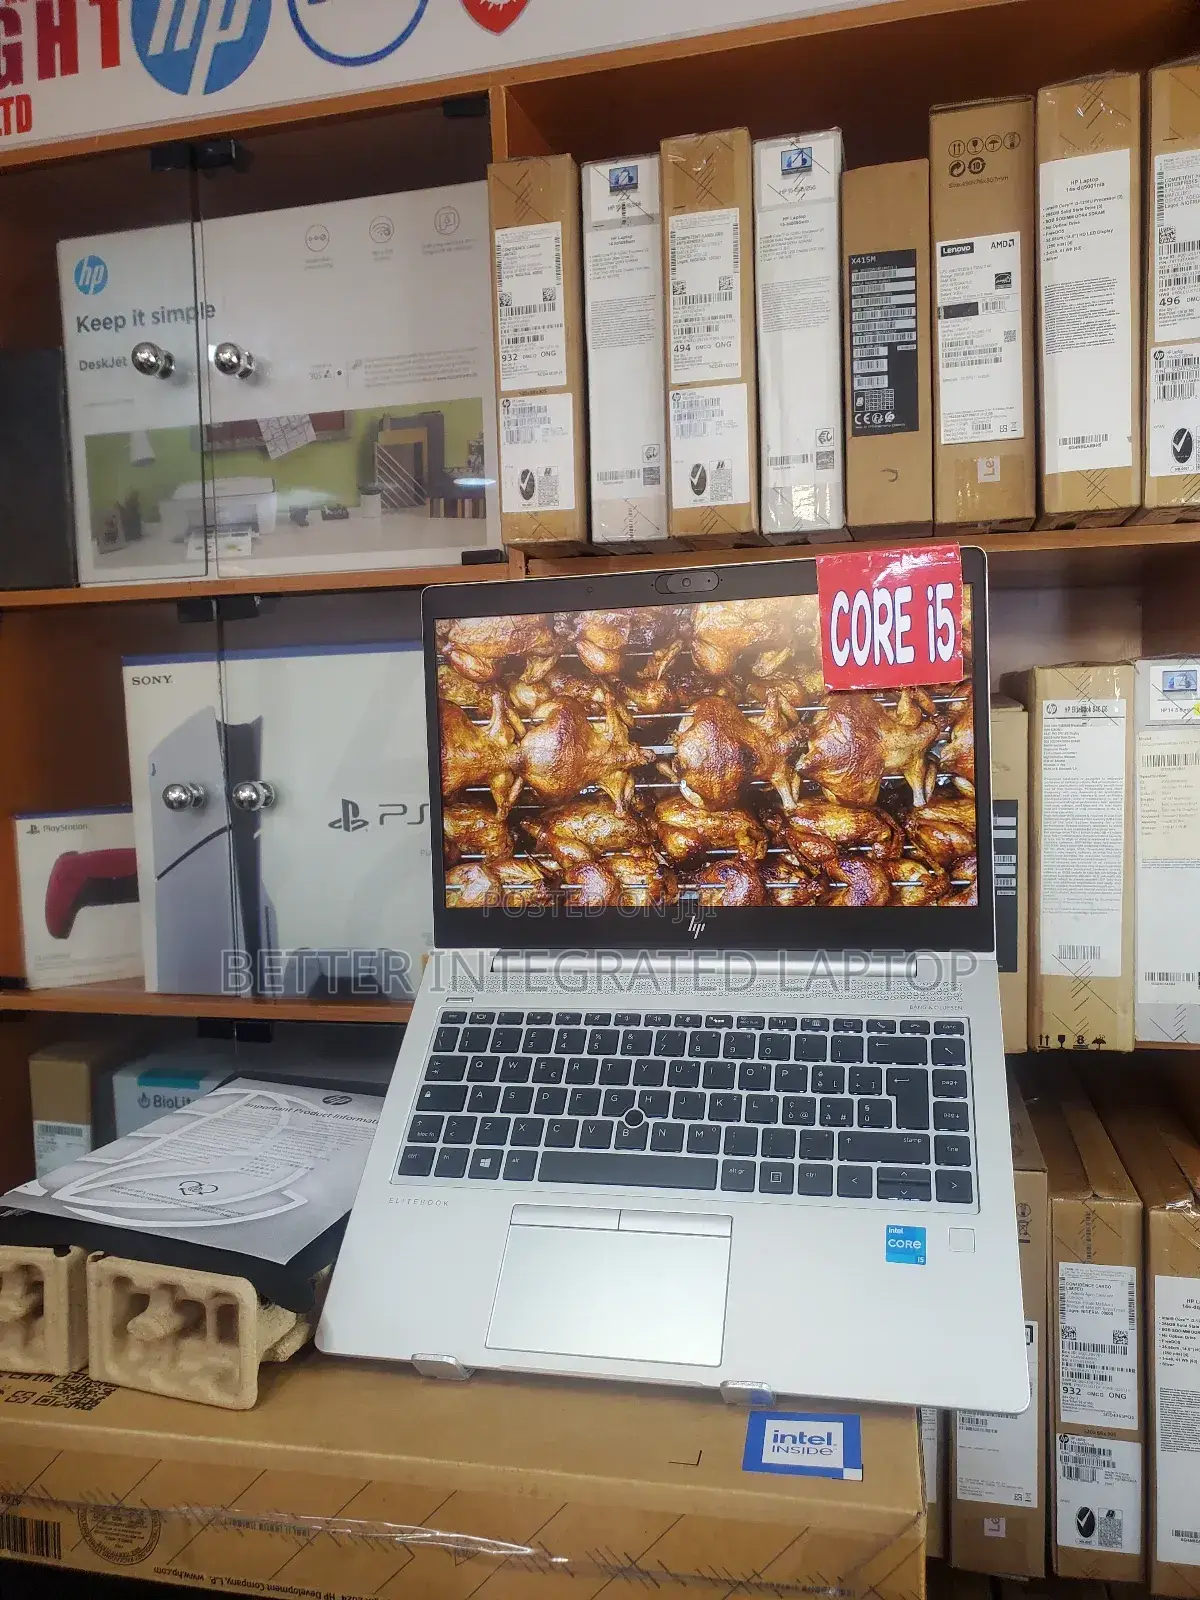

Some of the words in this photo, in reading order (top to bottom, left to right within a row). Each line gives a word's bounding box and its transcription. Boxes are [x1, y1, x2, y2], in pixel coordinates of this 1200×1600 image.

[0, 94, 33, 136] TD
[942, 244, 972, 255] Lenovo
[991, 240, 1008, 249] AMD
[851, 255, 877, 265] X415M
[79, 256, 104, 294] hp
[1159, 296, 1180, 306] 496
[76, 315, 127, 333] Keep
[132, 309, 145, 326] it
[151, 301, 216, 325] simple
[673, 344, 691, 353] 494
[501, 353, 518, 362] 932
[540, 350, 557, 358] ONG
[79, 356, 128, 371] DeskJet
[830, 585, 916, 667] CORE
[927, 582, 956, 665] i5
[131, 675, 172, 687] SONY
[43, 822, 88, 834] PlayStation
[688, 916, 706, 939] hp
[508, 1061, 518, 1069] W
[573, 1063, 580, 1071] R
[606, 1063, 613, 1071] T
[675, 1065, 683, 1073] U
[476, 1091, 484, 1099] A
[542, 1092, 549, 1100] D
[611, 1094, 618, 1102] G
[645, 1095, 652, 1103] H
[153, 1094, 191, 1109] BioLit
[244, 1102, 292, 1113] Important
[293, 1108, 332, 1119] Product
[588, 1126, 595, 1134] V
[659, 1129, 666, 1137] N
[695, 1130, 704, 1138] M
[389, 1198, 449, 1206] ELITEBOOK
[888, 1226, 904, 1235] intel
[1062, 1386, 1082, 1396] 932
[1108, 1392, 1127, 1400] ONG
[772, 1430, 832, 1446] intel
[153, 1566, 205, 1581] www.hp.com
[225, 1577, 265, 1591] Company,
[267, 1583, 322, 1599] Development
